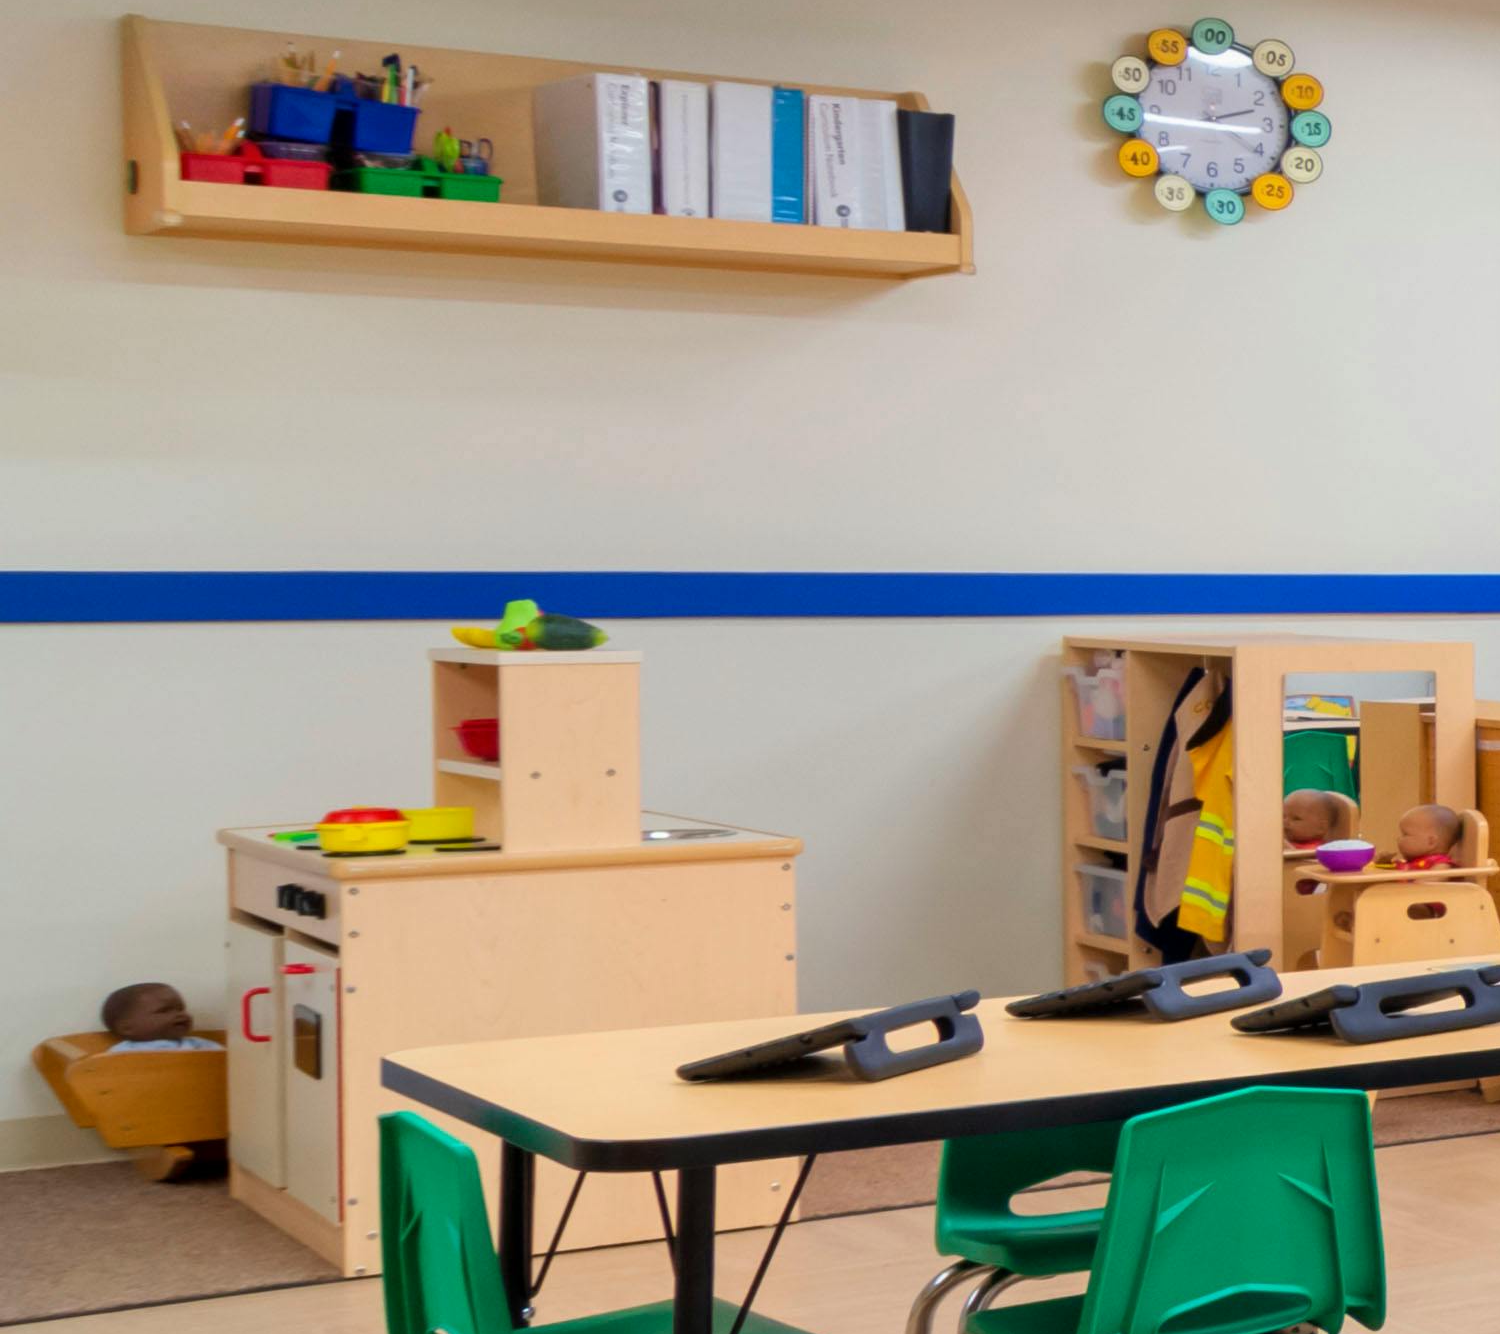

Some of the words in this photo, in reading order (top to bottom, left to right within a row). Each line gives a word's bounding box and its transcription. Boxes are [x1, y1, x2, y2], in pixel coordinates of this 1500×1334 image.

[1177, 68, 1192, 82] 11
[1158, 79, 1176, 95] 10
[1253, 91, 1265, 106] 2
[1262, 118, 1273, 133] 3
[1158, 132, 1170, 147] 8
[1253, 142, 1265, 157] 4
[1180, 153, 1191, 168] 7
[1233, 158, 1245, 173] 5
[1206, 162, 1218, 177] 6
